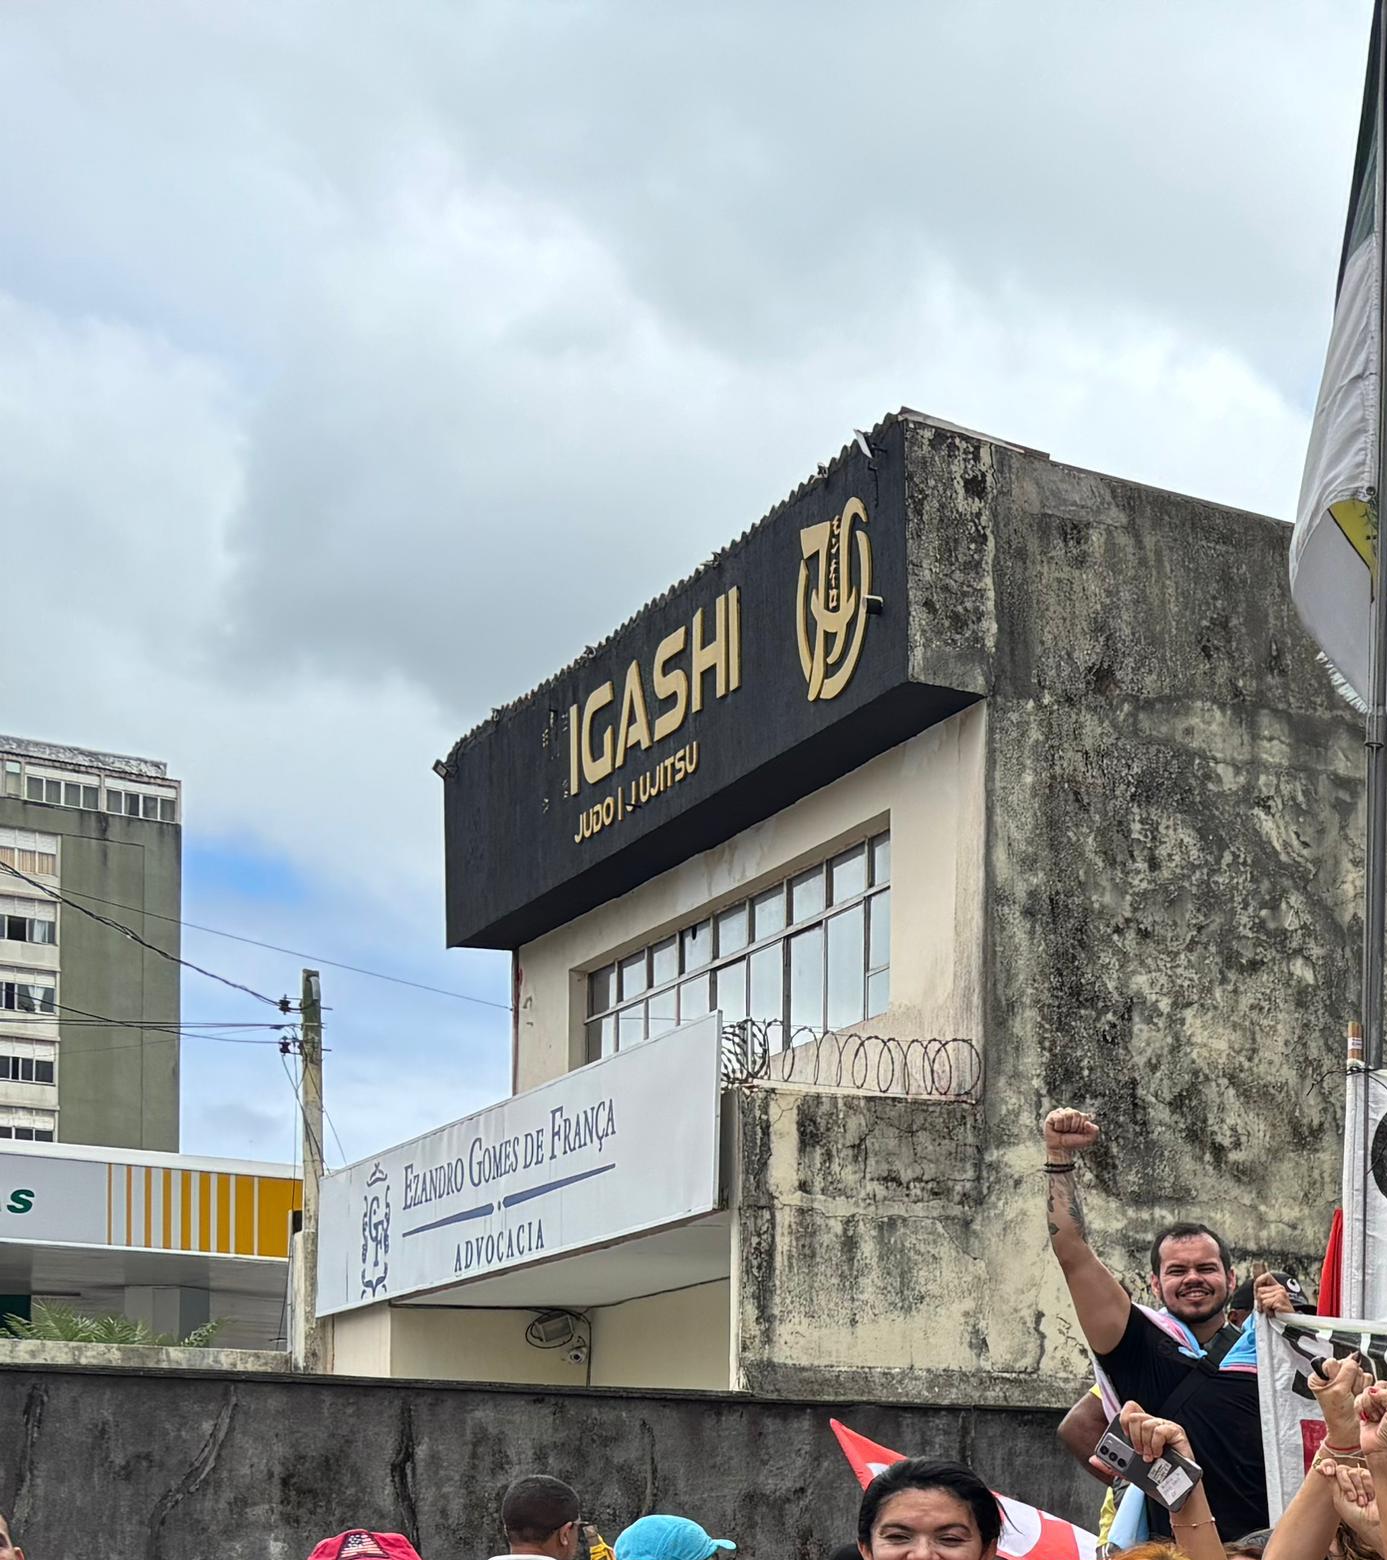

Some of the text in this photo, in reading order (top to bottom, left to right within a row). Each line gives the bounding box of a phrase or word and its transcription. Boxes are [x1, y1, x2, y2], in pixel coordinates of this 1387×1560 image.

[569, 585, 742, 796] IGASHI
[574, 796, 614, 843] JUDO
[402, 1158, 464, 1211] EZANDRO
[468, 1137, 520, 1188] GOMES
[550, 1098, 617, 1160] FRANÇA
[454, 1218, 545, 1273] ADVOCACIA
